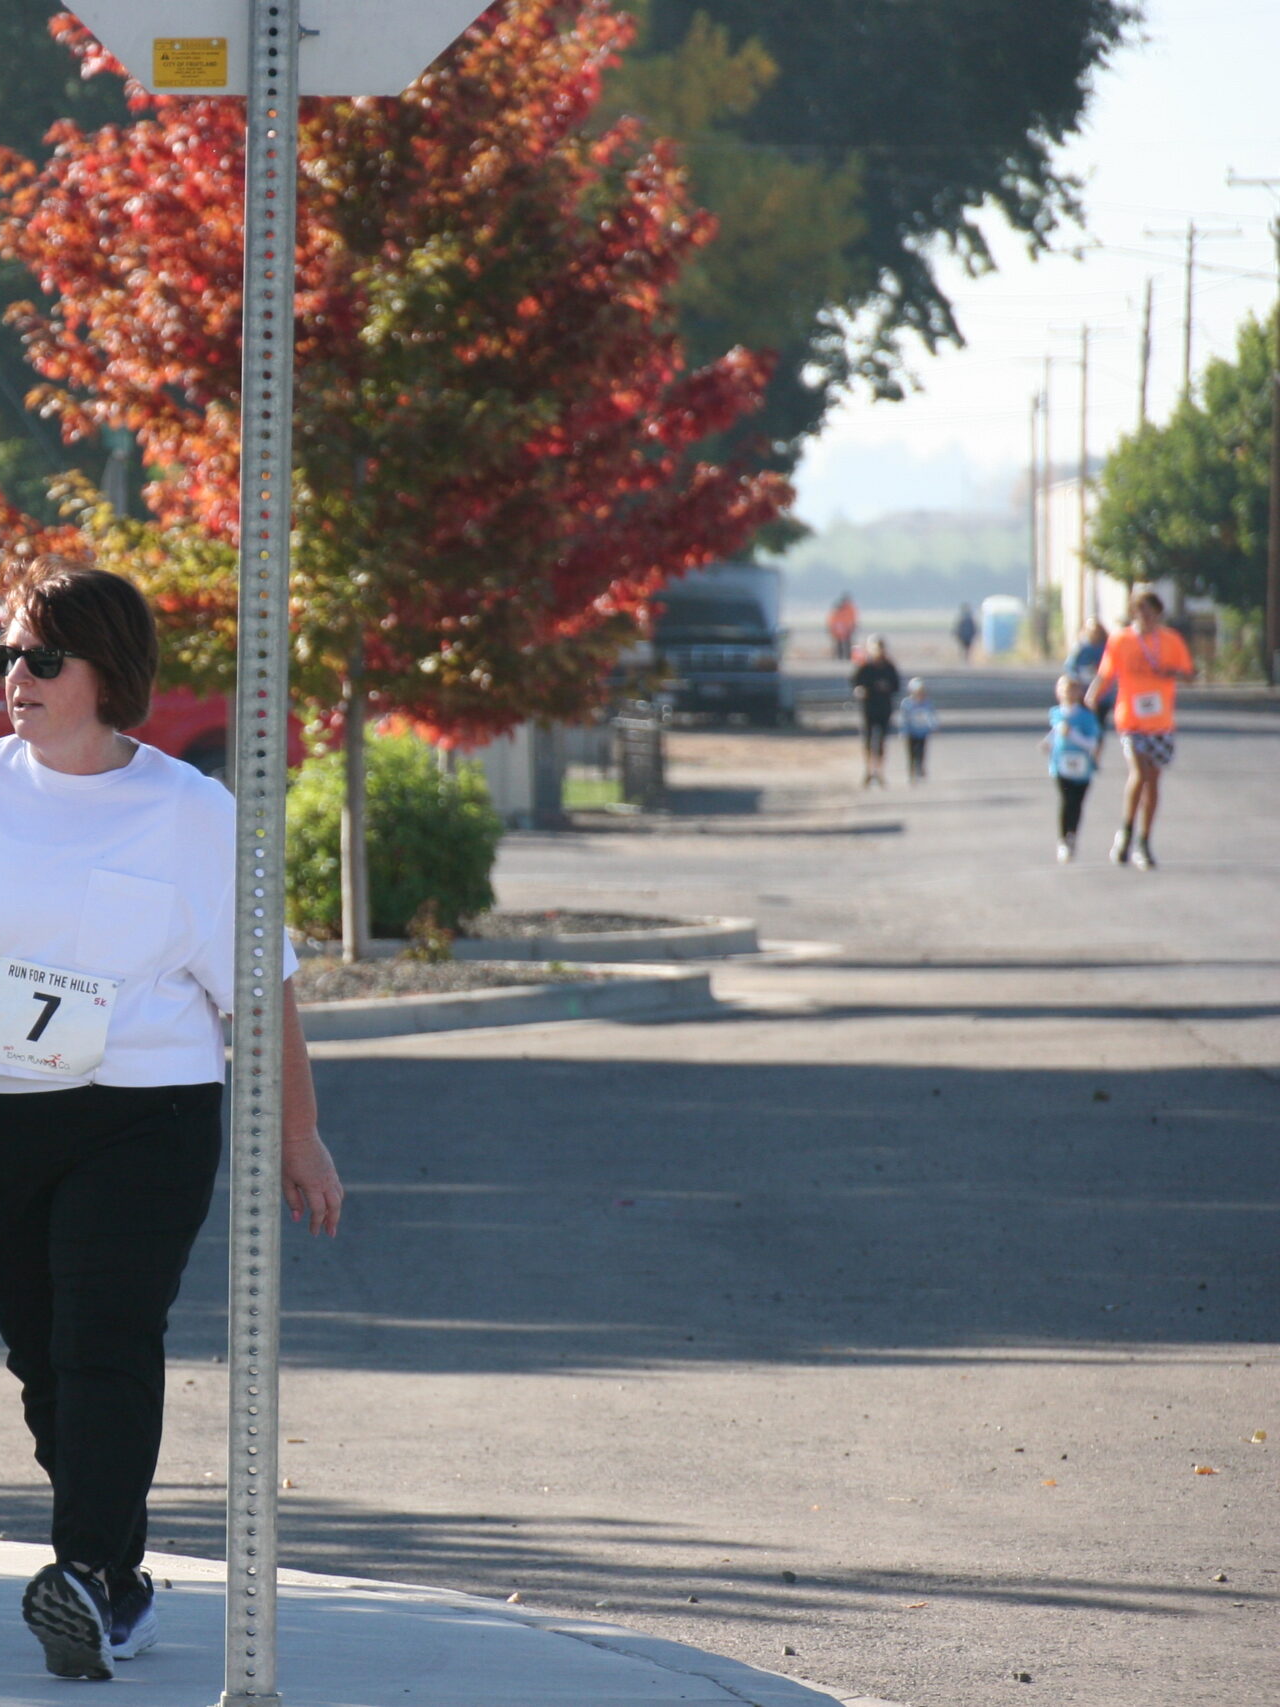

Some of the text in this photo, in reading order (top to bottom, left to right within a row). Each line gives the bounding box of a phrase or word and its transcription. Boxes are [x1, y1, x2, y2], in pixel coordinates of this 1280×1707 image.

[8, 964, 99, 995] RUN FOR THE HILLS
[26, 991, 62, 1043] 7
